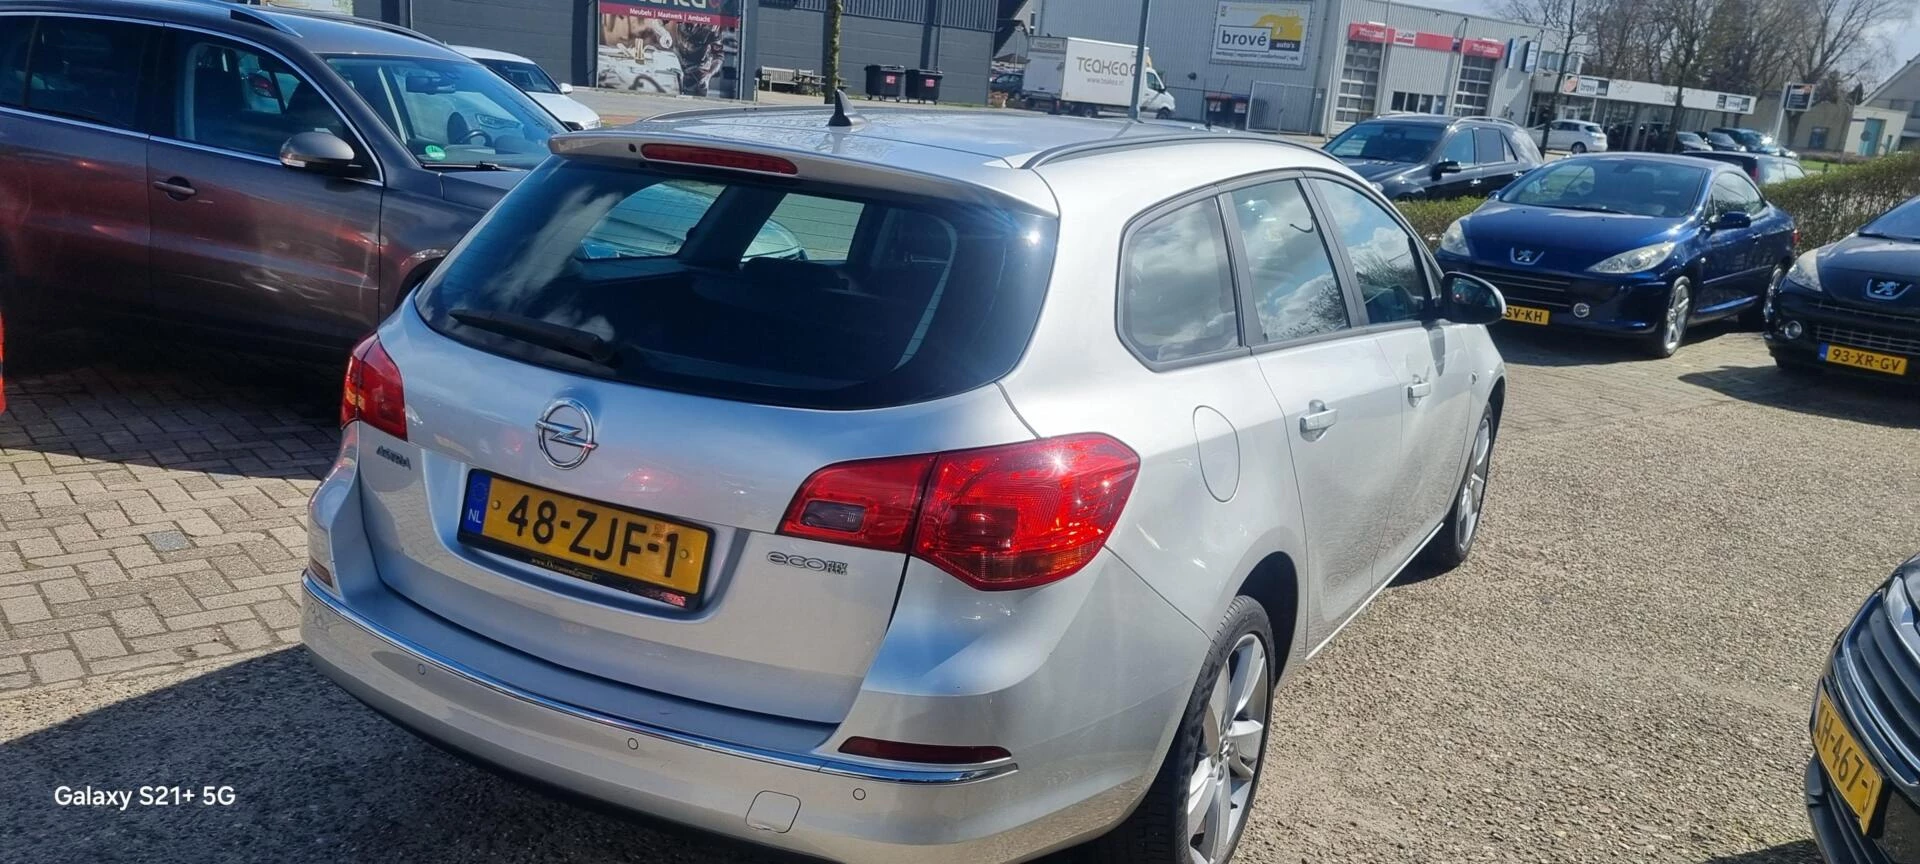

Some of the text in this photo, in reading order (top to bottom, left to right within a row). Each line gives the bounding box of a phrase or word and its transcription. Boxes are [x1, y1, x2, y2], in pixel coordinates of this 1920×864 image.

[629, 8, 652, 17] Meubels
[1221, 29, 1267, 46] brové
[1832, 348, 1901, 372] 93-XR-GV
[468, 508, 482, 524] NL
[507, 494, 679, 578] 48-ZJF-1
